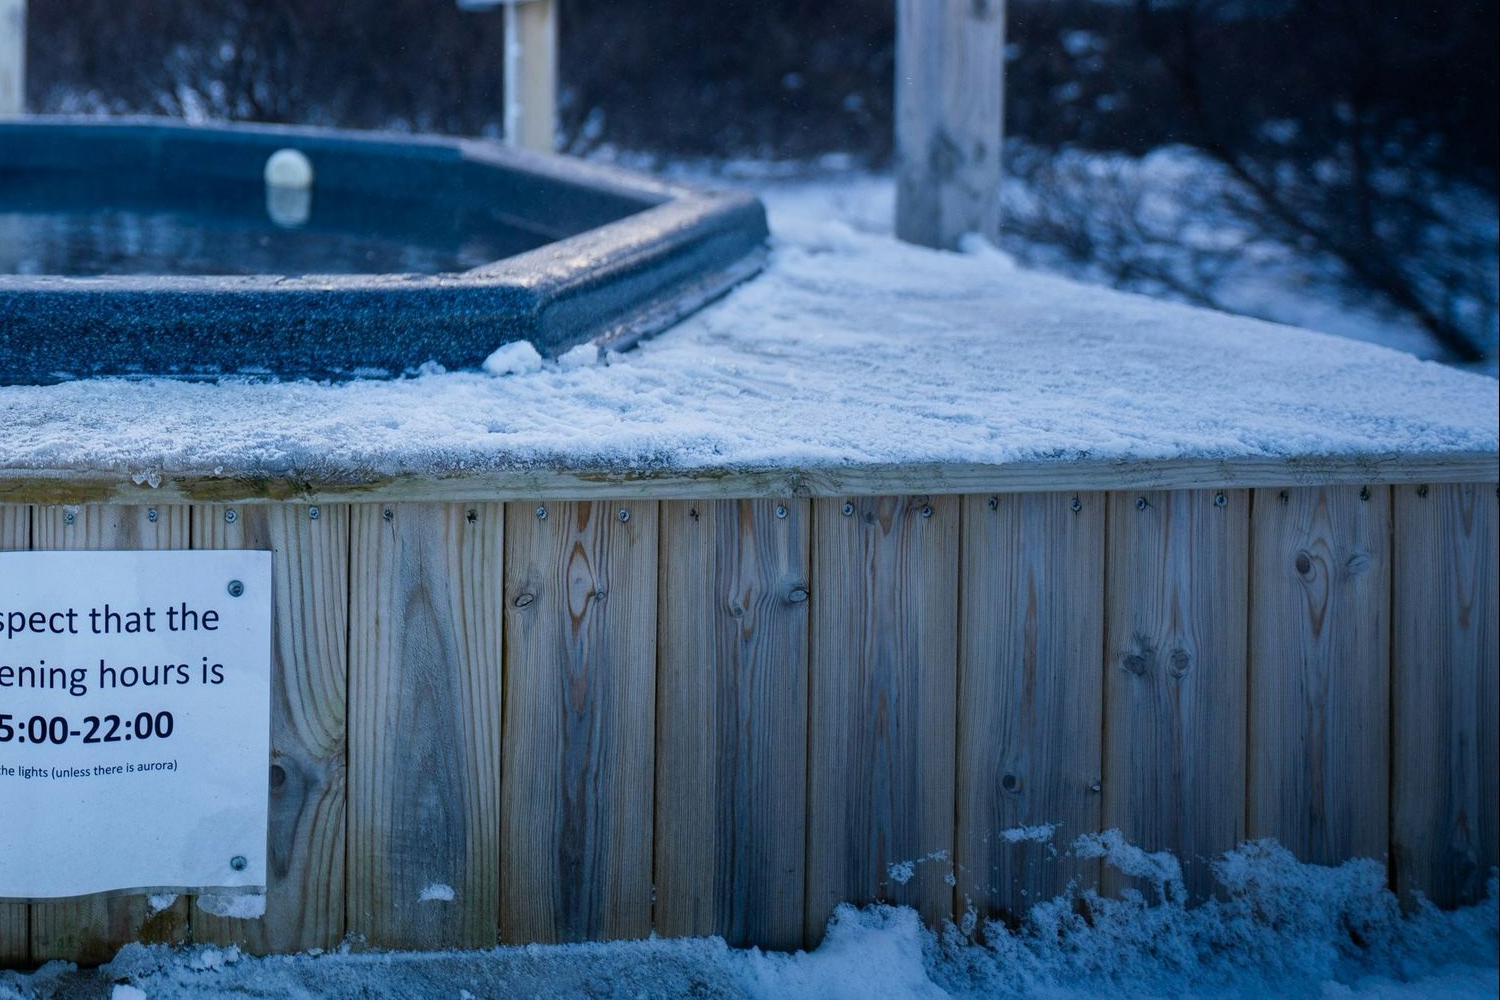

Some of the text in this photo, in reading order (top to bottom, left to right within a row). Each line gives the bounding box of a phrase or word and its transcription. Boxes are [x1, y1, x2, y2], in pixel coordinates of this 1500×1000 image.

[89, 604, 156, 634] that
[166, 602, 219, 631] the
[100, 659, 189, 688] hours
[202, 657, 224, 684] is
[19, 765, 48, 779] lights
[52, 766, 91, 779] (unless
[94, 765, 123, 776] there
[126, 762, 134, 773] is
[137, 759, 178, 772] aurora)
